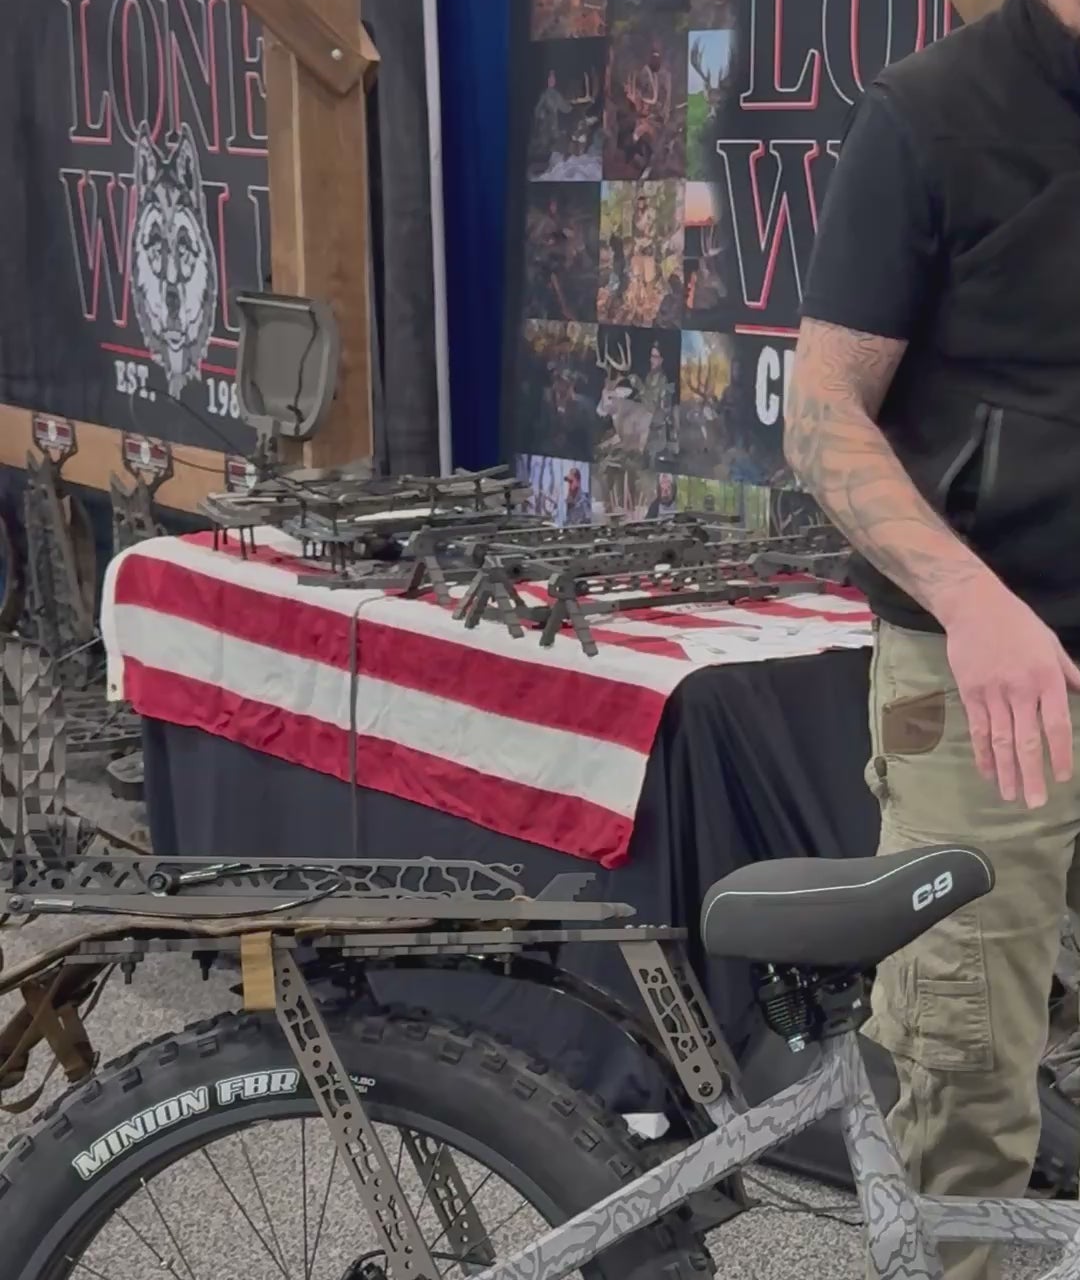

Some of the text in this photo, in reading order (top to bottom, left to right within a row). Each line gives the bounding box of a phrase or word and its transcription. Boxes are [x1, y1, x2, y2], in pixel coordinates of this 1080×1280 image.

[114, 360, 156, 402] EST.
[72, 1067, 300, 1181] MINION FBR
